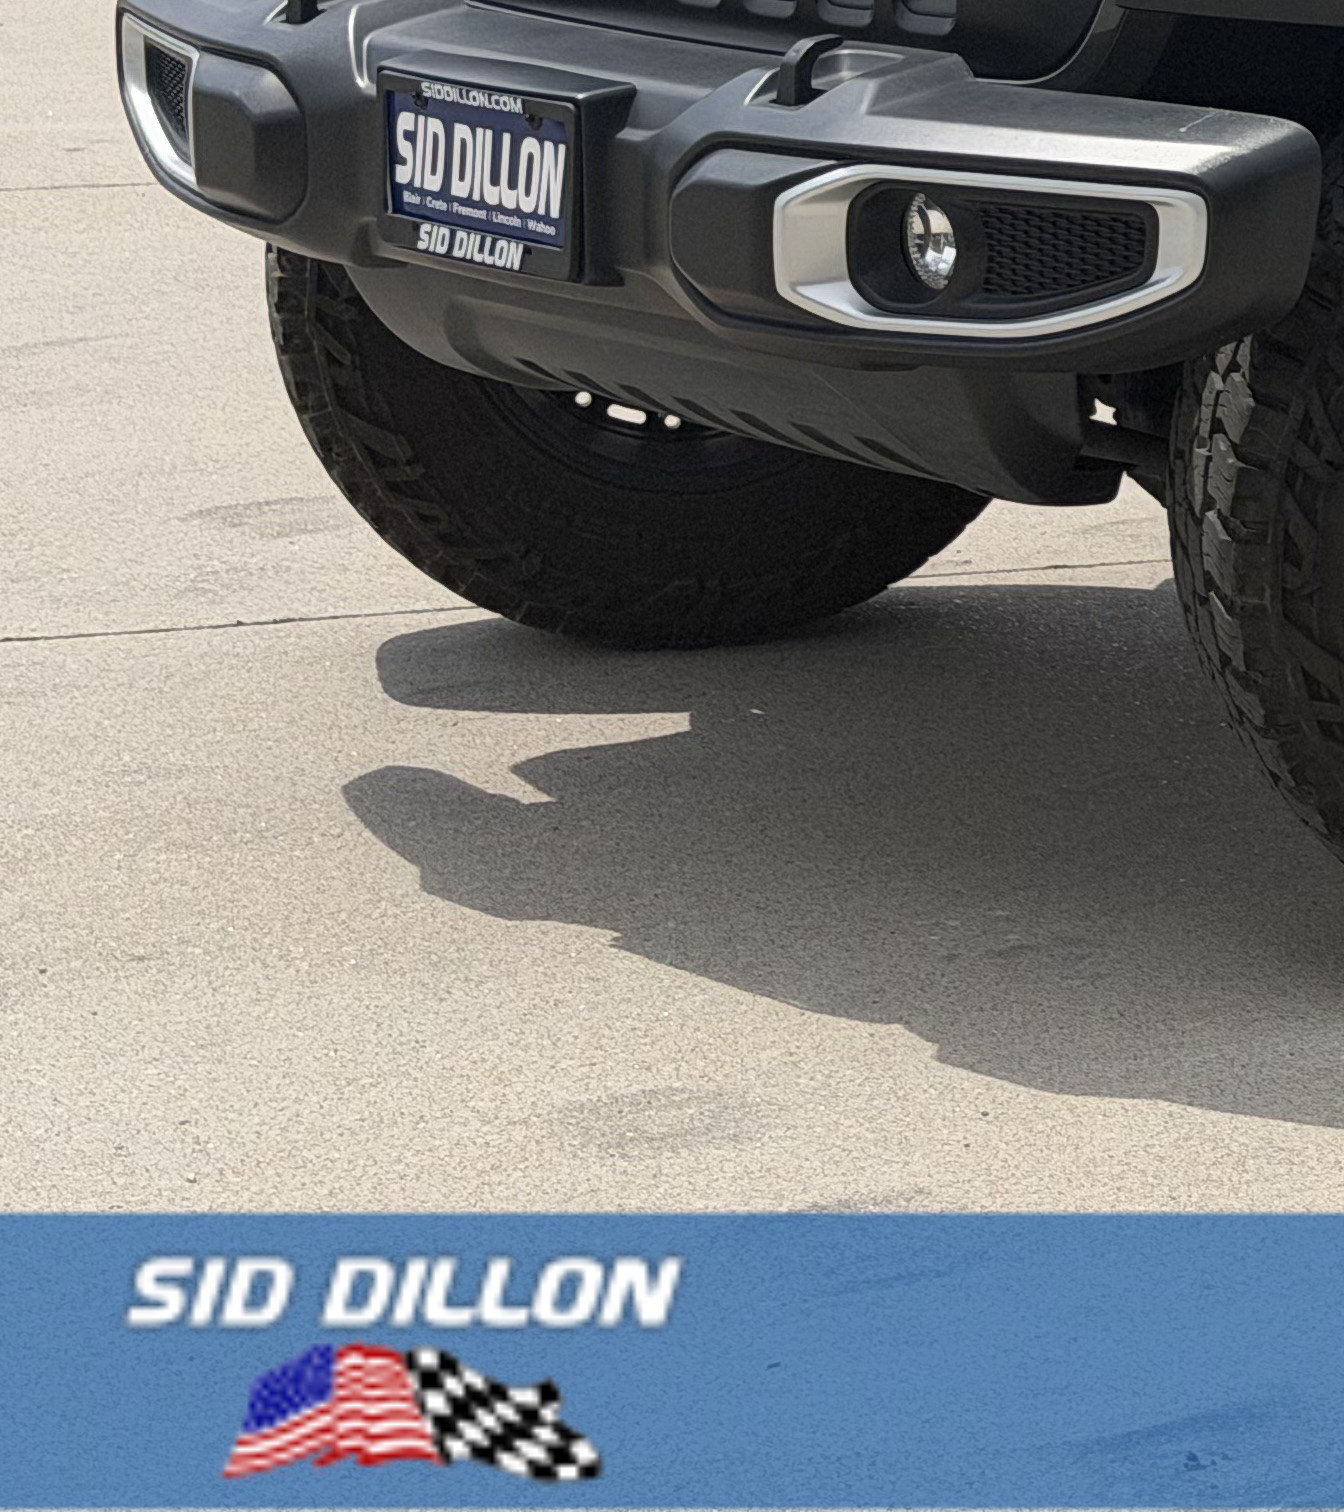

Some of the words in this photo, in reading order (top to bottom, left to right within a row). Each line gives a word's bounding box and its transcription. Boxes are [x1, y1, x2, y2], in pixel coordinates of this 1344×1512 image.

[421, 82, 524, 115] SIDDILLON.COM
[395, 111, 446, 193] SID
[450, 122, 567, 220] DILLON
[417, 223, 451, 255] SID
[452, 231, 525, 271] DILLON
